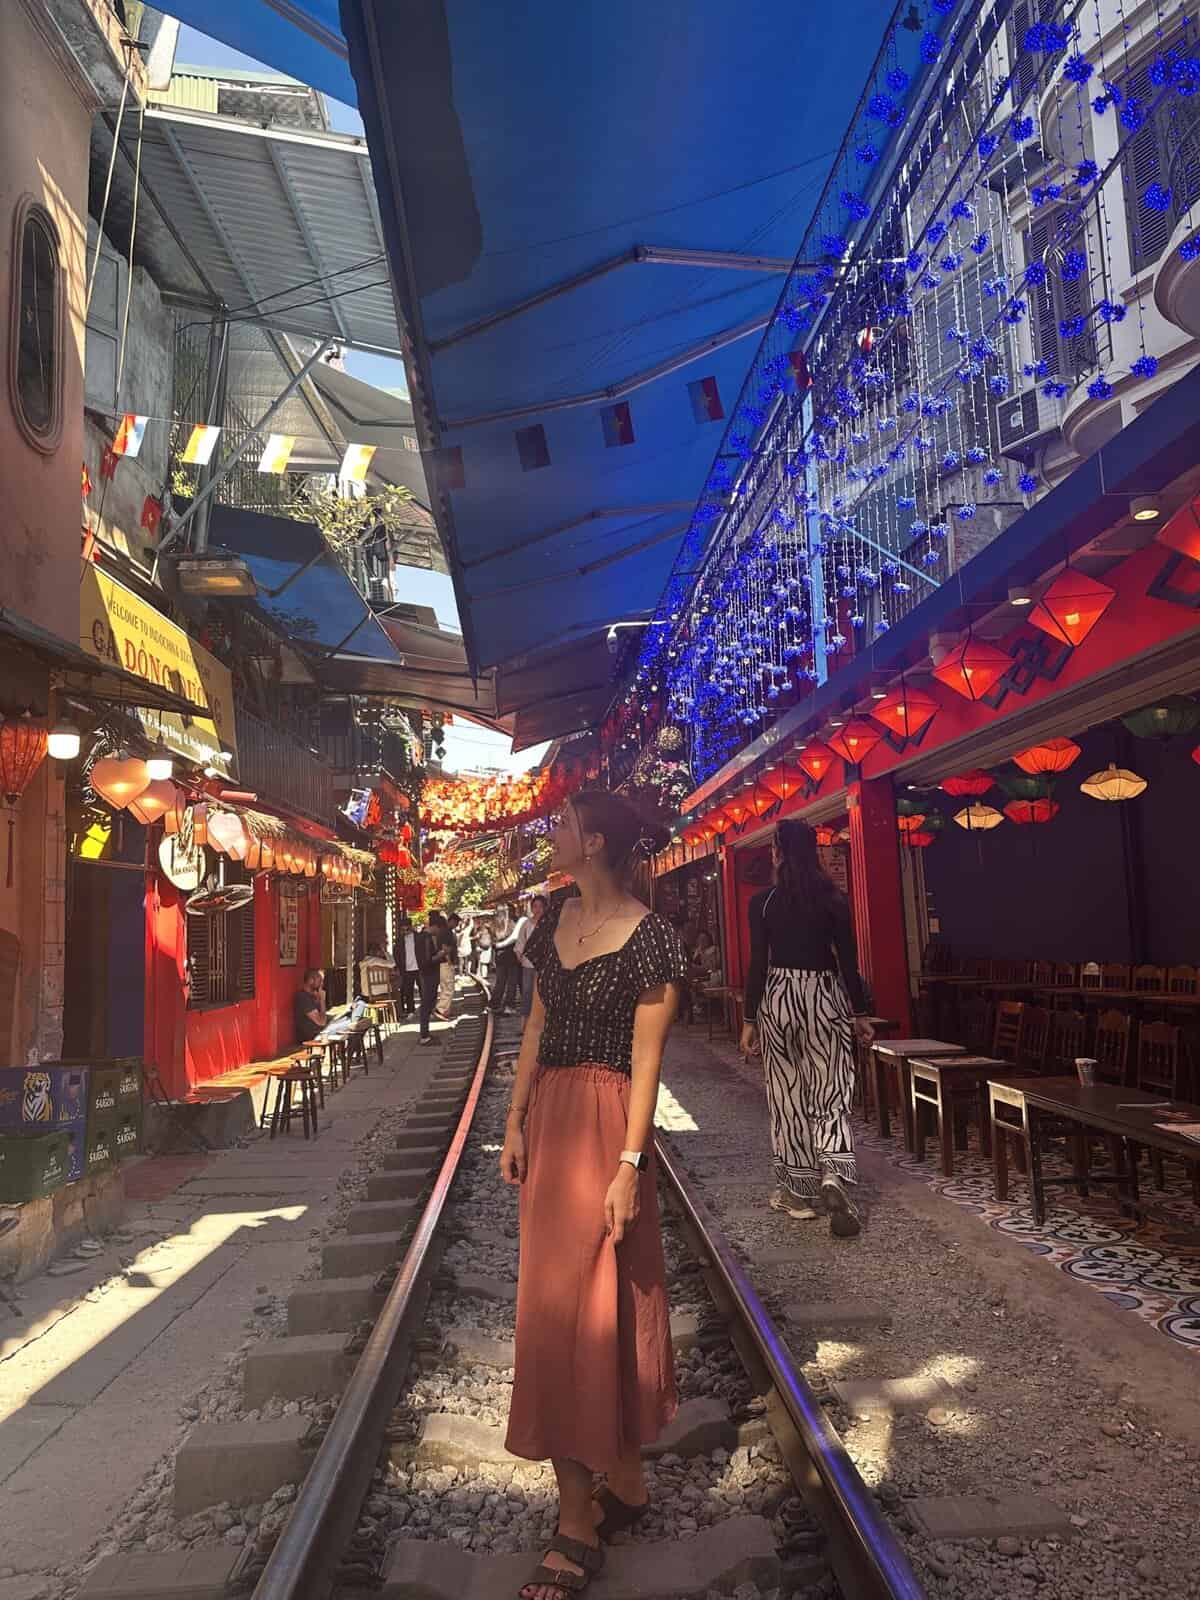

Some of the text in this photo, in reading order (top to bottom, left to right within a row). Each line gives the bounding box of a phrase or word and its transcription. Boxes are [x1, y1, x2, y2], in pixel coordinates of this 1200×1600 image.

[106, 593, 139, 630] WELCOME
[140, 619, 149, 636] TO
[92, 619, 118, 662] GA
